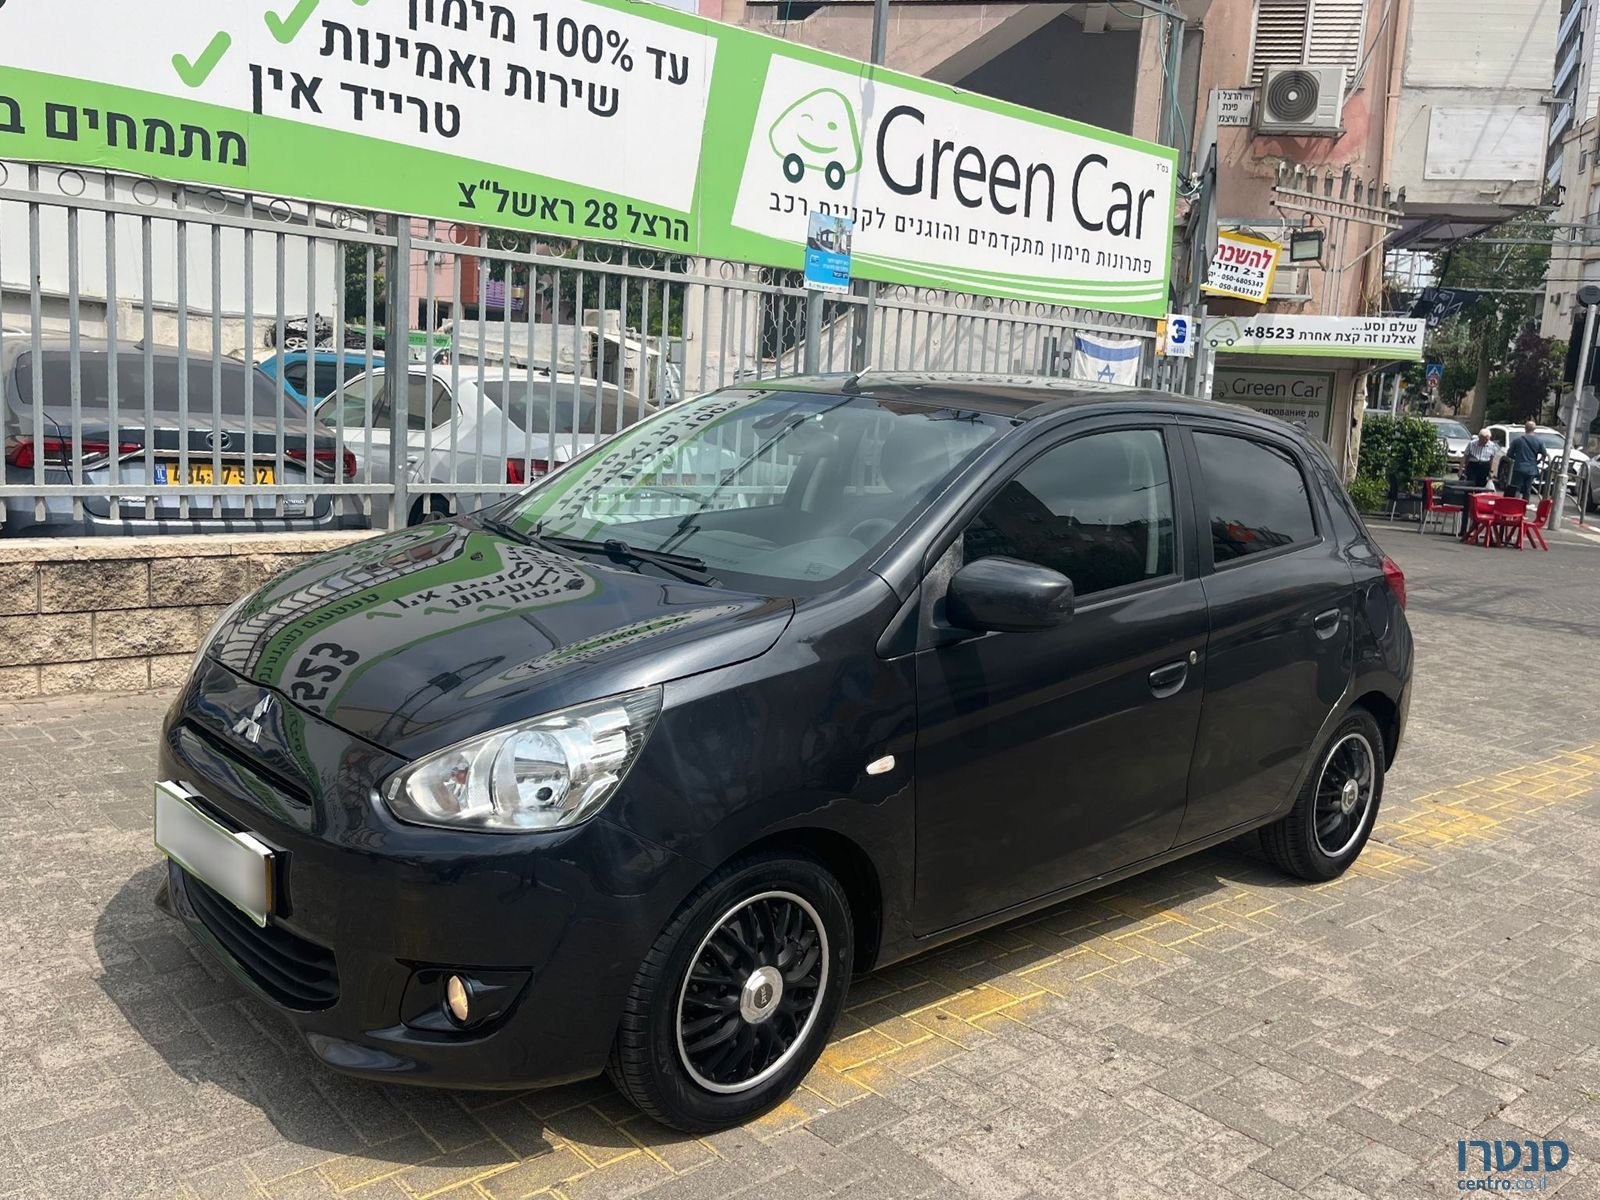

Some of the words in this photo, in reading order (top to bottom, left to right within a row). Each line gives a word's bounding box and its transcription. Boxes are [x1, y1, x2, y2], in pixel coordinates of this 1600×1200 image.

[408, 0, 516, 44] מימון
[319, 19, 490, 92] ואמינות
[532, 12, 634, 73] 100%
[645, 46, 689, 86] עד
[248, 62, 324, 116] אין
[504, 62, 619, 118] שירות
[1223, 91, 1242, 100] הרצל
[339, 81, 461, 138] טרייד
[1222, 103, 1238, 111] פינת
[45, 102, 248, 167] מתמחים
[876, 105, 1056, 223] Green
[1071, 153, 1155, 240] Car
[584, 199, 618, 231] 28
[769, 191, 808, 216] רכב
[627, 204, 689, 243] הרצל
[894, 215, 961, 242] והוגנים
[967, 228, 1045, 258] מתקדמים
[1050, 242, 1092, 266] מימון
[1218, 243, 1273, 270] להשכר
[1096, 250, 1153, 275] פתרונות
[1221, 273, 1264, 288] 050-6805347
[1298, 331, 1331, 341] אחרת
[1334, 332, 1361, 345] קצת
[1364, 333, 1378, 343] זה
[1381, 333, 1417, 345] אצלנו
[1389, 321, 1417, 333] שלם
[1232, 377, 1286, 396] Green
[1291, 380, 1323, 398] Car
[1308, 410, 1320, 419] до
